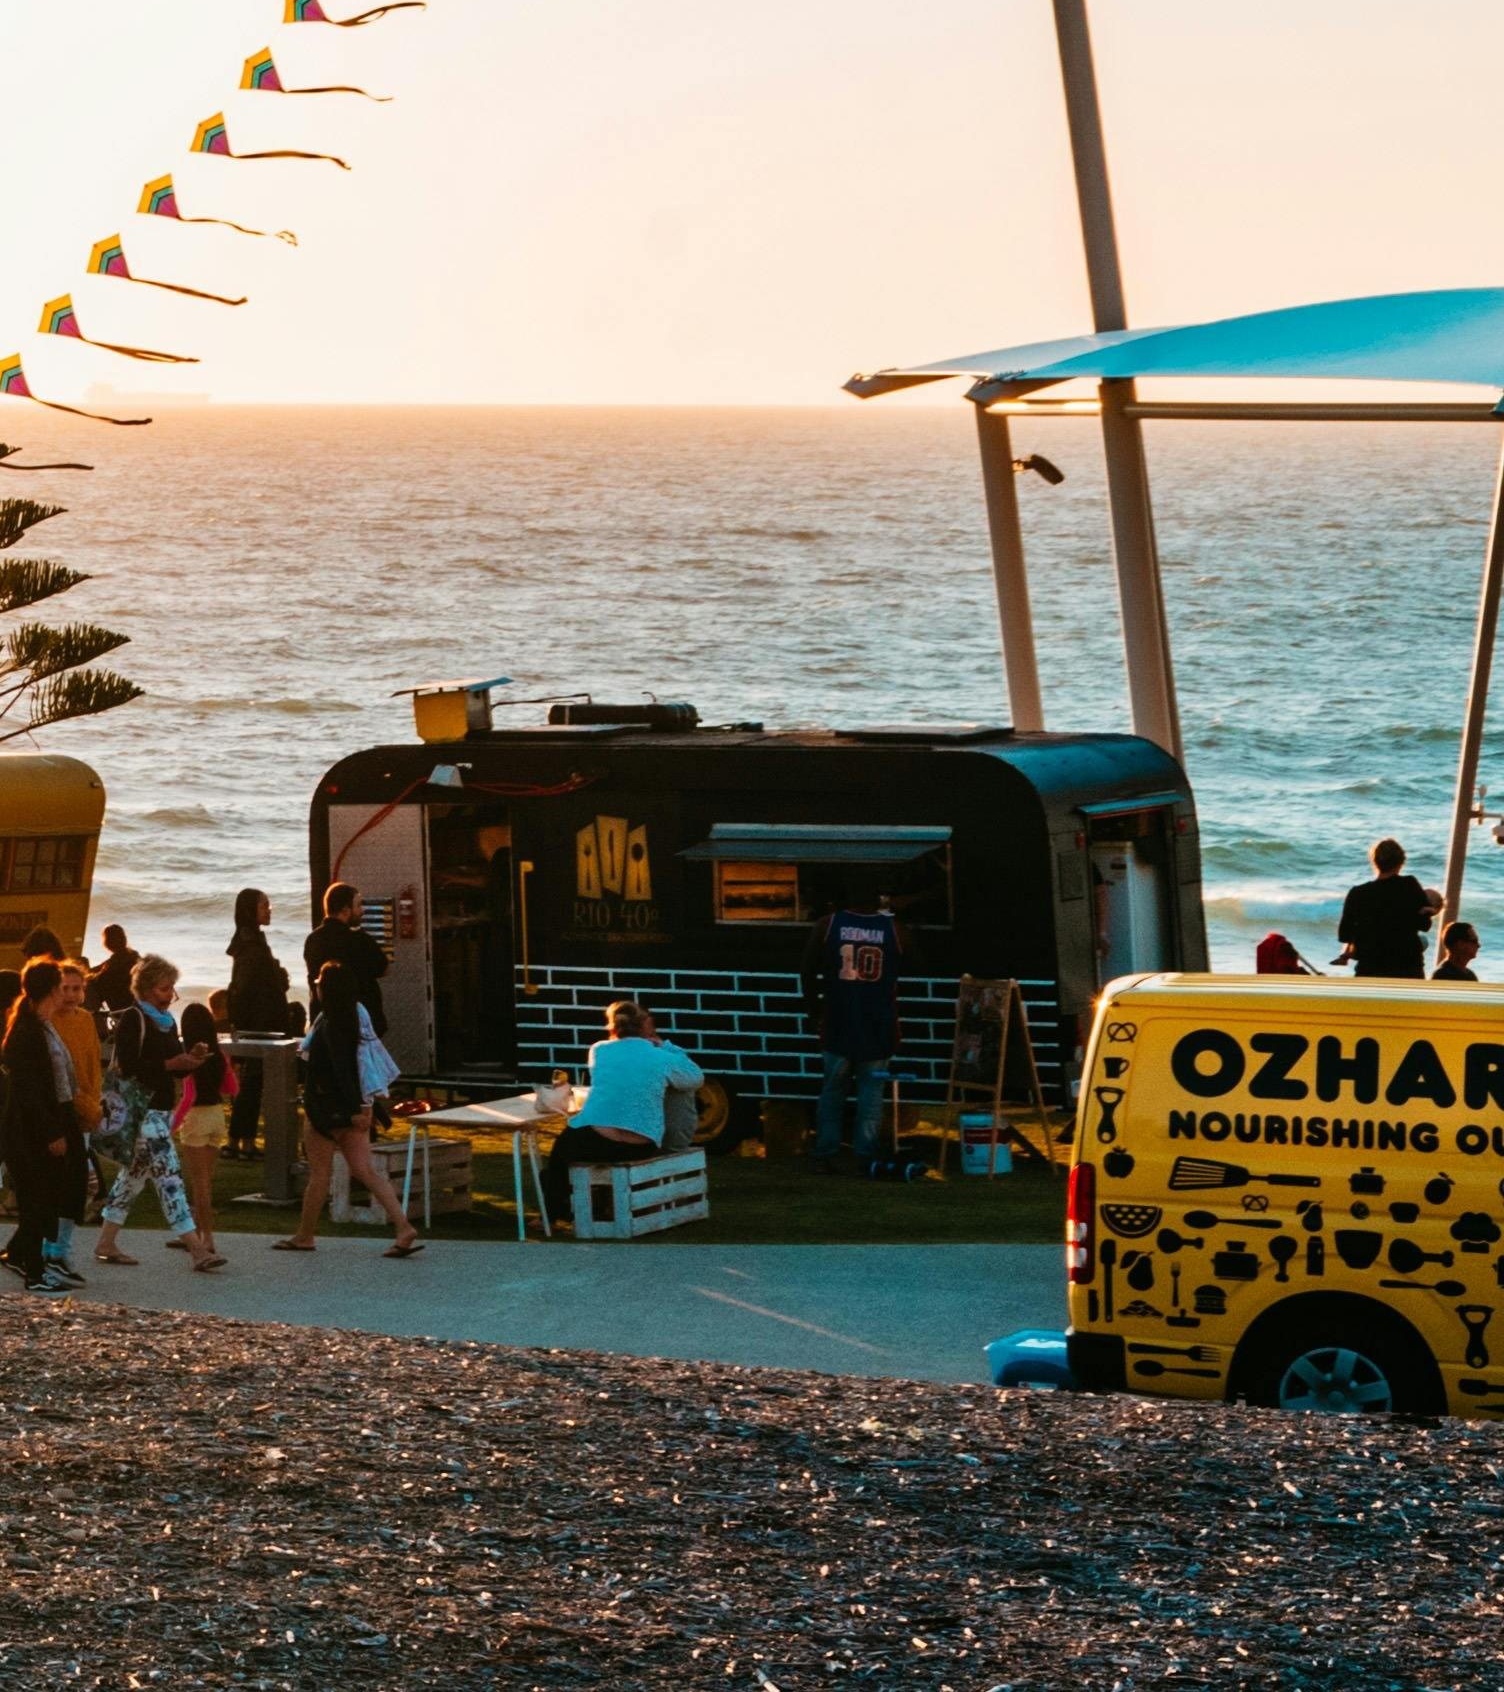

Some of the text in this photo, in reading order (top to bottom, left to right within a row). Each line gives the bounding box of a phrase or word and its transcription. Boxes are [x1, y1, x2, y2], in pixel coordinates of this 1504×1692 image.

[838, 943, 883, 982] 10
[1171, 1027, 1504, 1111] OZHAR
[1168, 1110, 1439, 1153] NOURISHING
